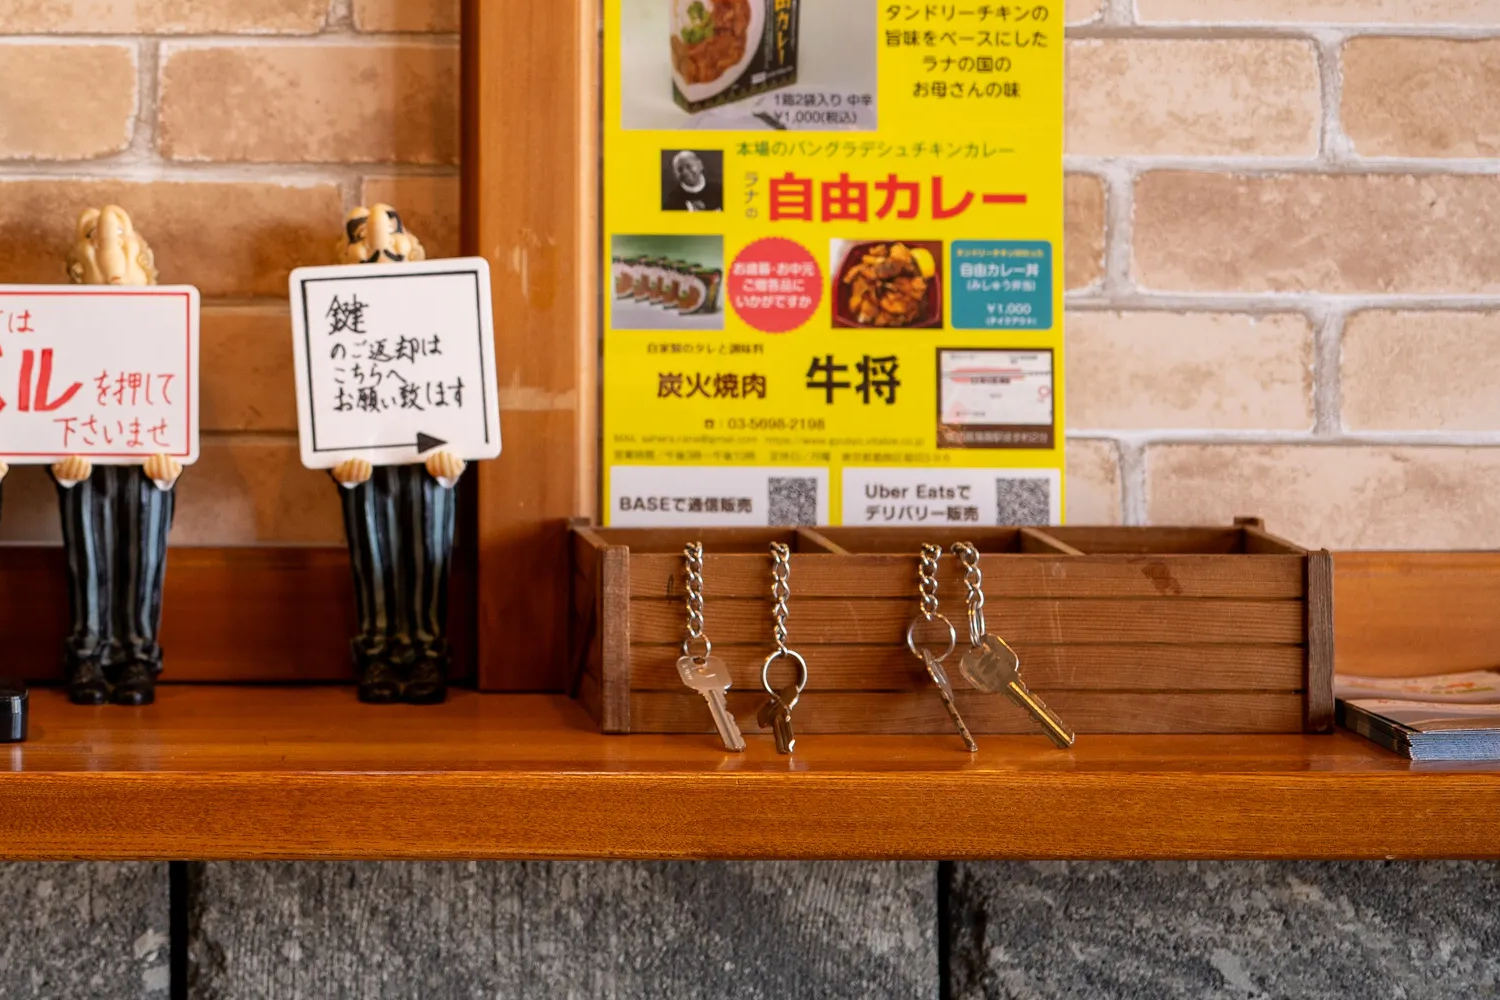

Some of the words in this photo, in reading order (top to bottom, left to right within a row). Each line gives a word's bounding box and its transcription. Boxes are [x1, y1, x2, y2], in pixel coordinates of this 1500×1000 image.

[886, 3, 1049, 22] タンドリーチキンの
[885, 29, 1048, 48] 旨味をベースにした
[923, 55, 1012, 73] ラナの国の
[912, 81, 1022, 99] お母さんの味
[736, 140, 1015, 159] 本場のバングラデシュチキンカレー
[769, 172, 1028, 222] 自由カレー
[325, 294, 369, 335] 鍵
[330, 334, 442, 364] のご返却は
[334, 363, 408, 385] こちらへ
[657, 372, 767, 399] 炭火焼肉
[806, 354, 901, 405] 牛将
[94, 370, 176, 406] を押して
[333, 376, 465, 413] お願い致します
[53, 414, 170, 448] 下さいませ
[865, 483, 911, 499] Uber
[916, 483, 972, 500] Eatsで
[619, 496, 752, 513] BASEで通信販売
[865, 505, 979, 521] デリバリー販売
